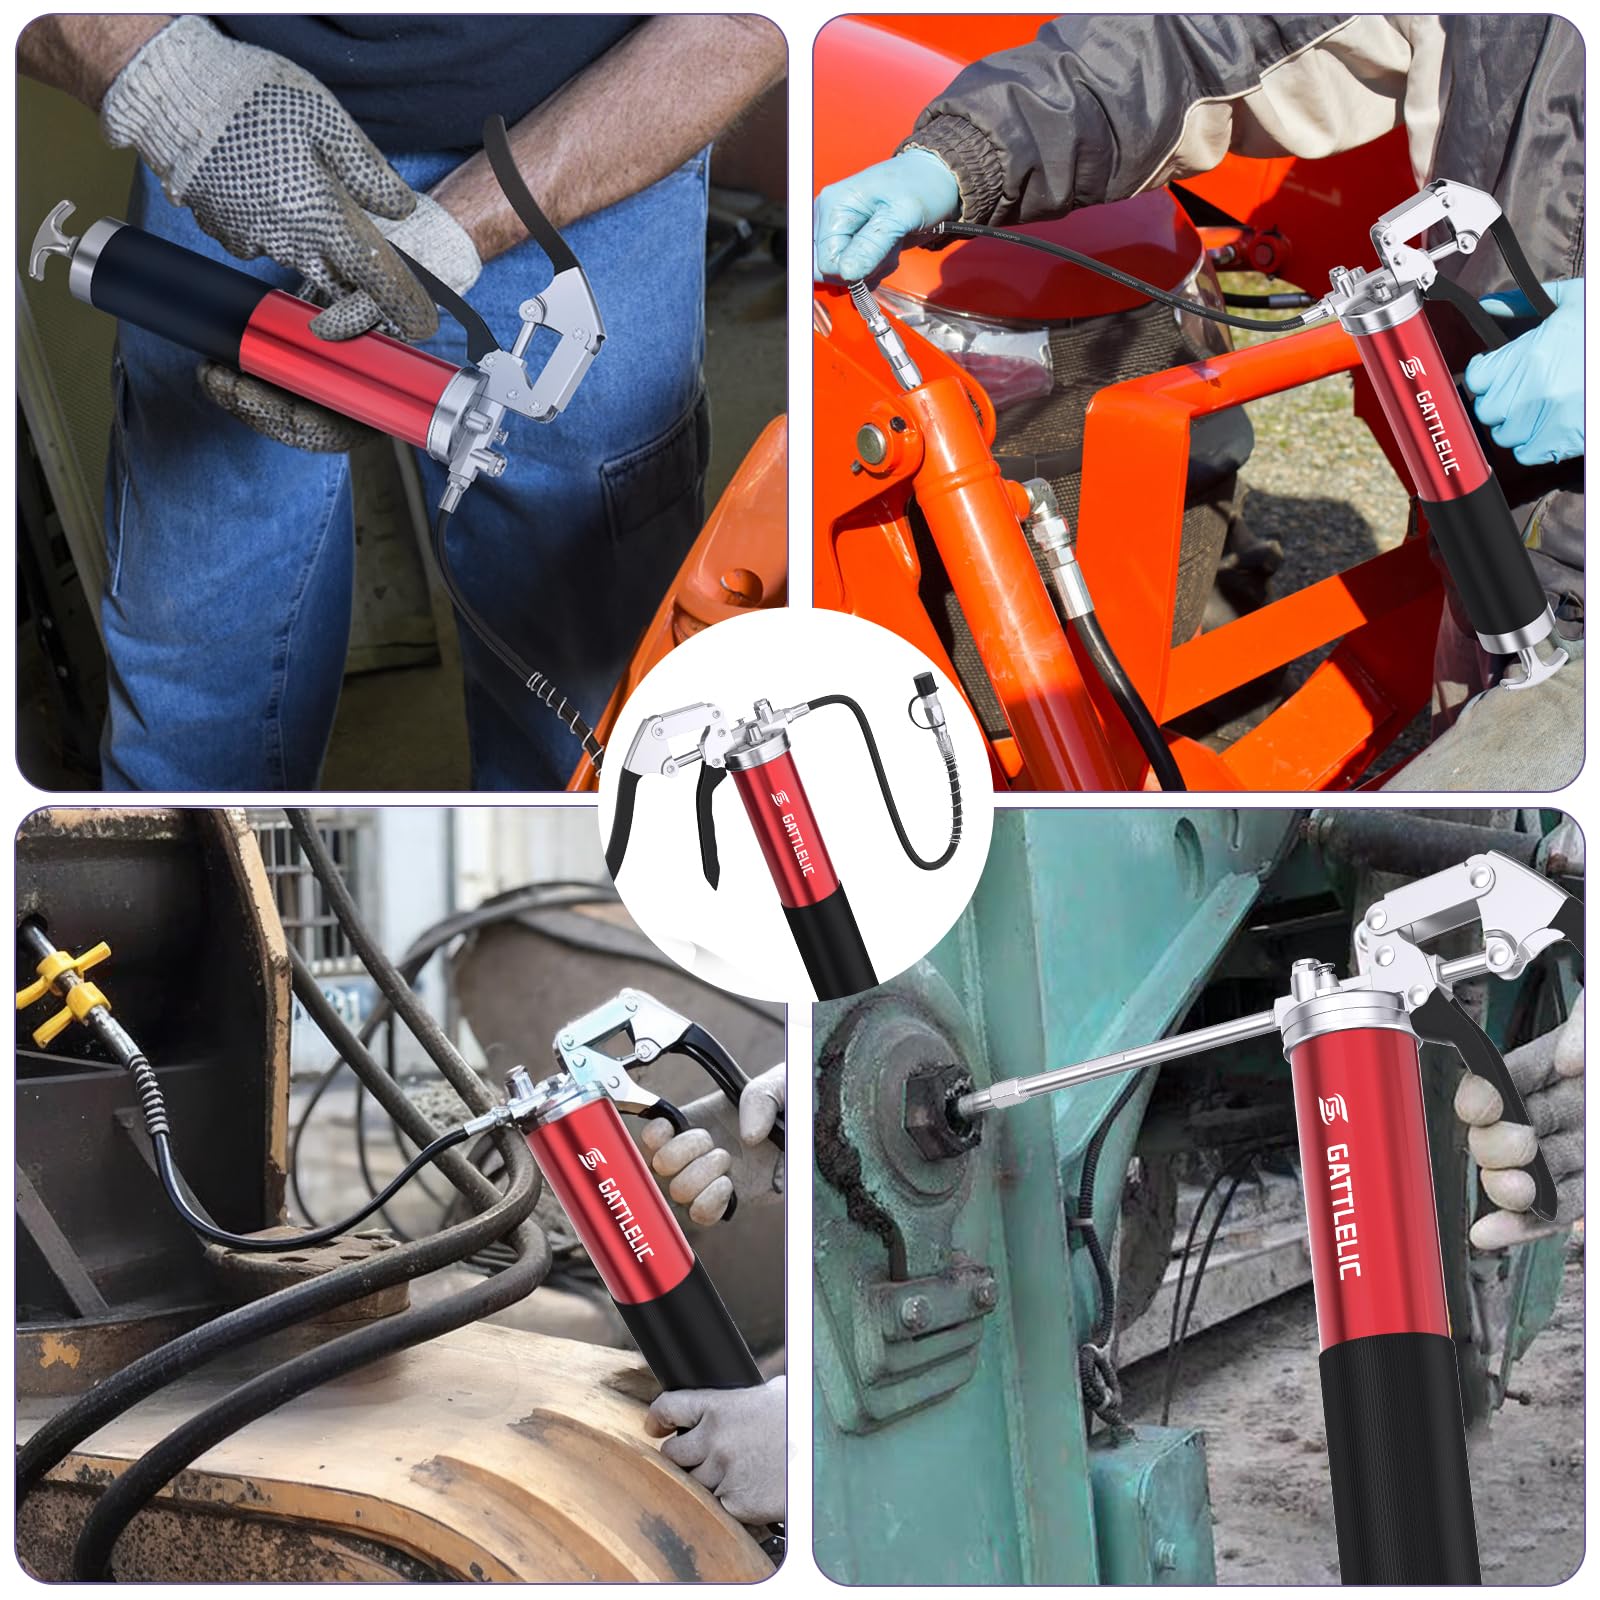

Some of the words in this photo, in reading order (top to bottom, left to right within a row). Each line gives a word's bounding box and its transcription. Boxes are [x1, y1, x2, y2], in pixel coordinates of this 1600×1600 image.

[1415, 390, 1461, 476] GATTLELIC
[782, 813, 815, 877] GATTLELIC
[598, 1177, 655, 1263] GATTLELIC
[1326, 1143, 1362, 1281] GATTLELIC
